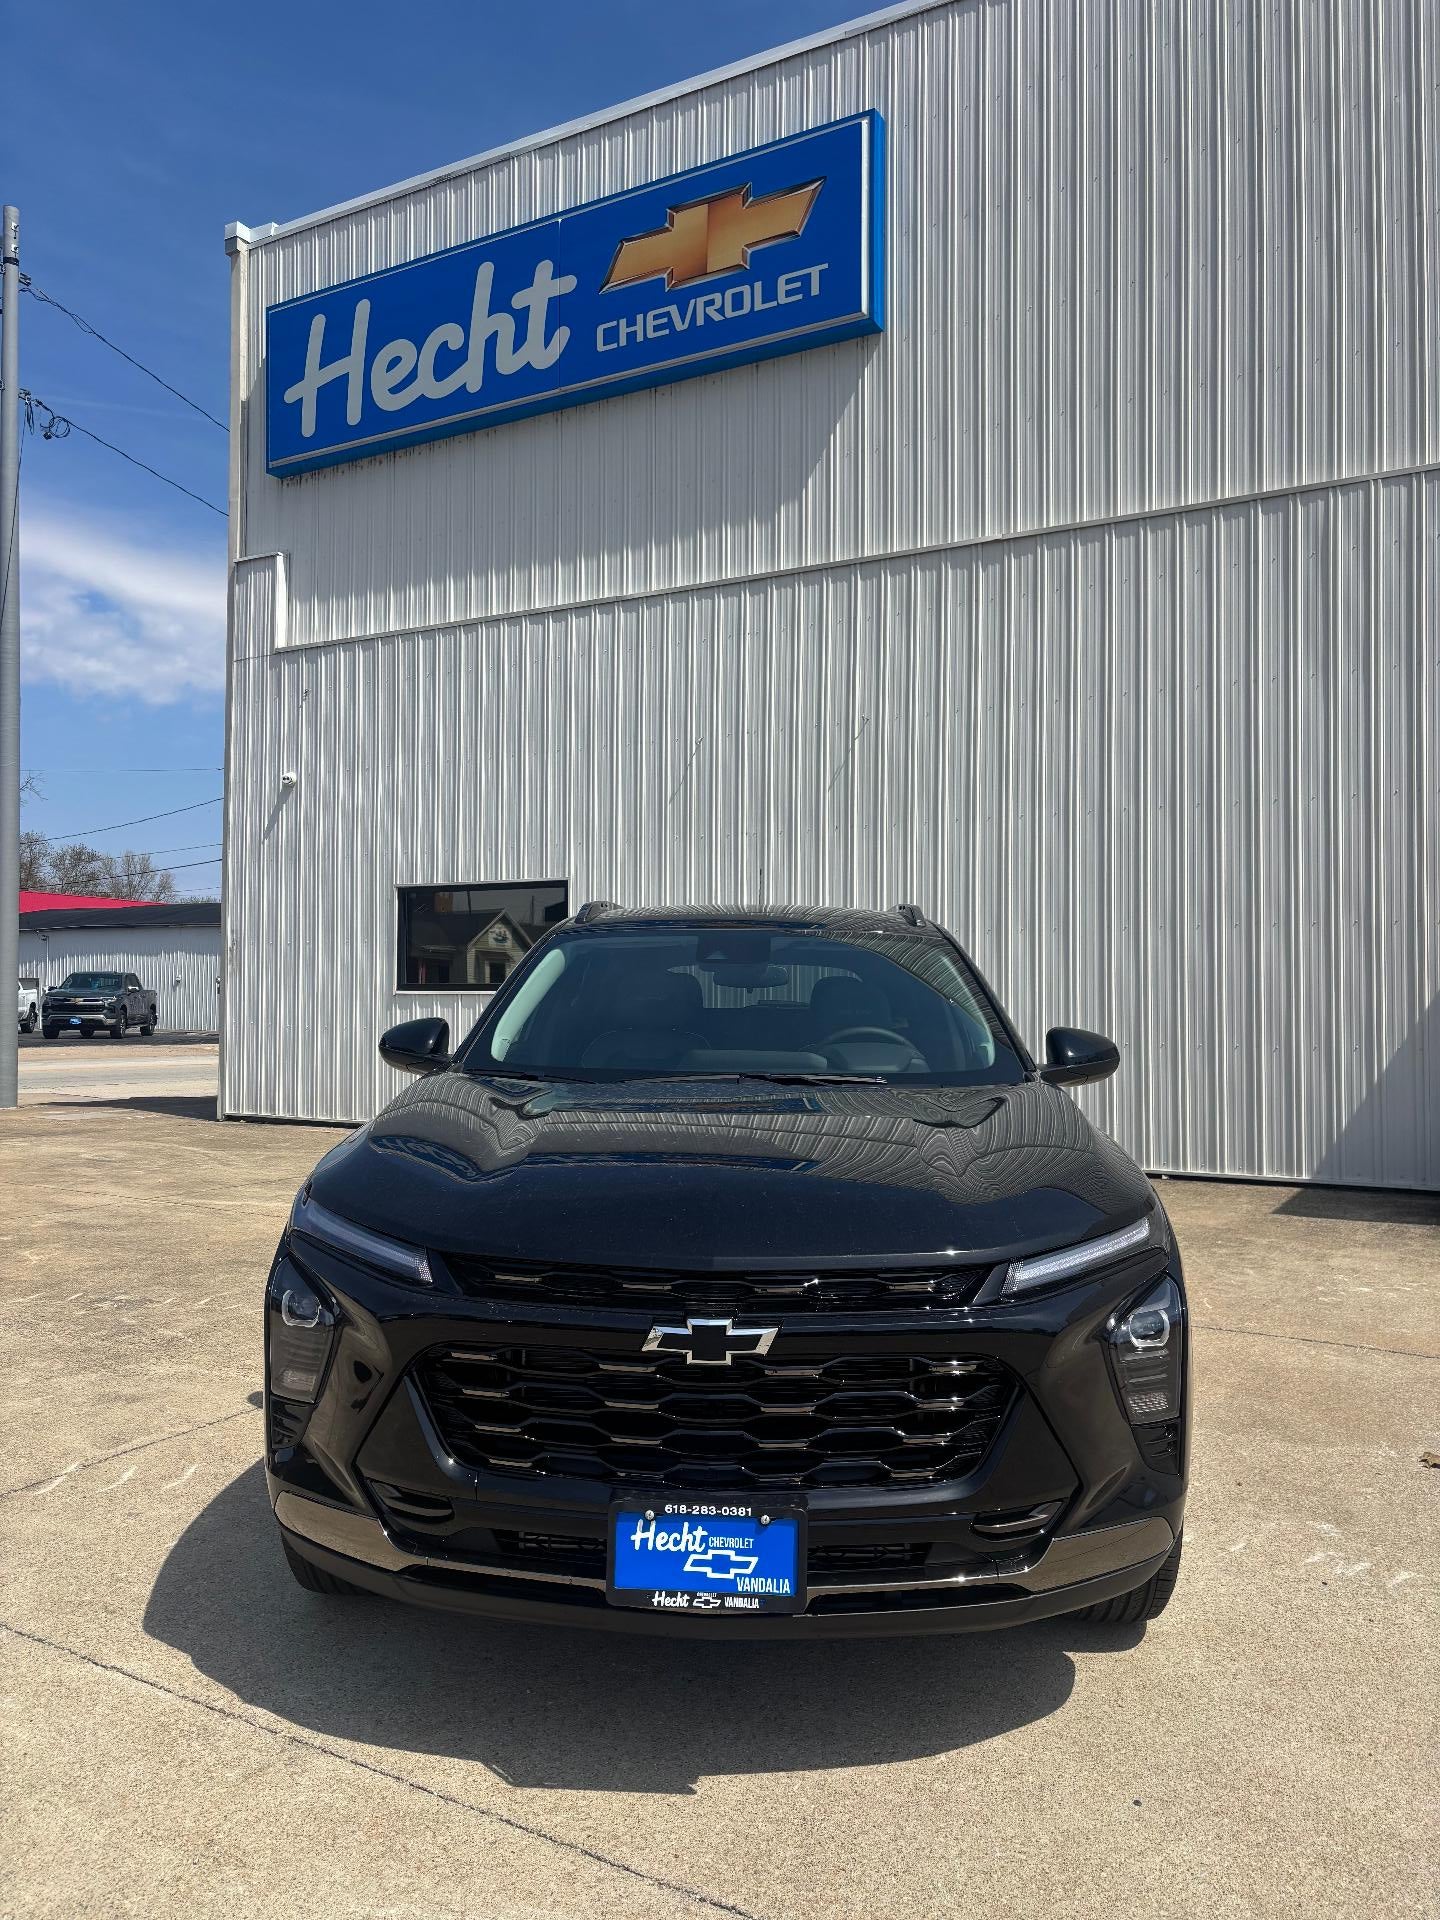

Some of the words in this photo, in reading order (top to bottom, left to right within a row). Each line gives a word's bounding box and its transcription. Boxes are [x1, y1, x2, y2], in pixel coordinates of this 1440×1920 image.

[596, 263, 829, 353] CHEVROLET
[284, 259, 577, 437] Hecht
[664, 1504, 752, 1516] 618-283-0381
[631, 1519, 708, 1552] Hecht
[708, 1536, 754, 1549] CHEVROLET
[736, 1577, 790, 1594] VANDALIA
[652, 1590, 690, 1608] Hecht
[724, 1596, 760, 1609] VANDALIA
